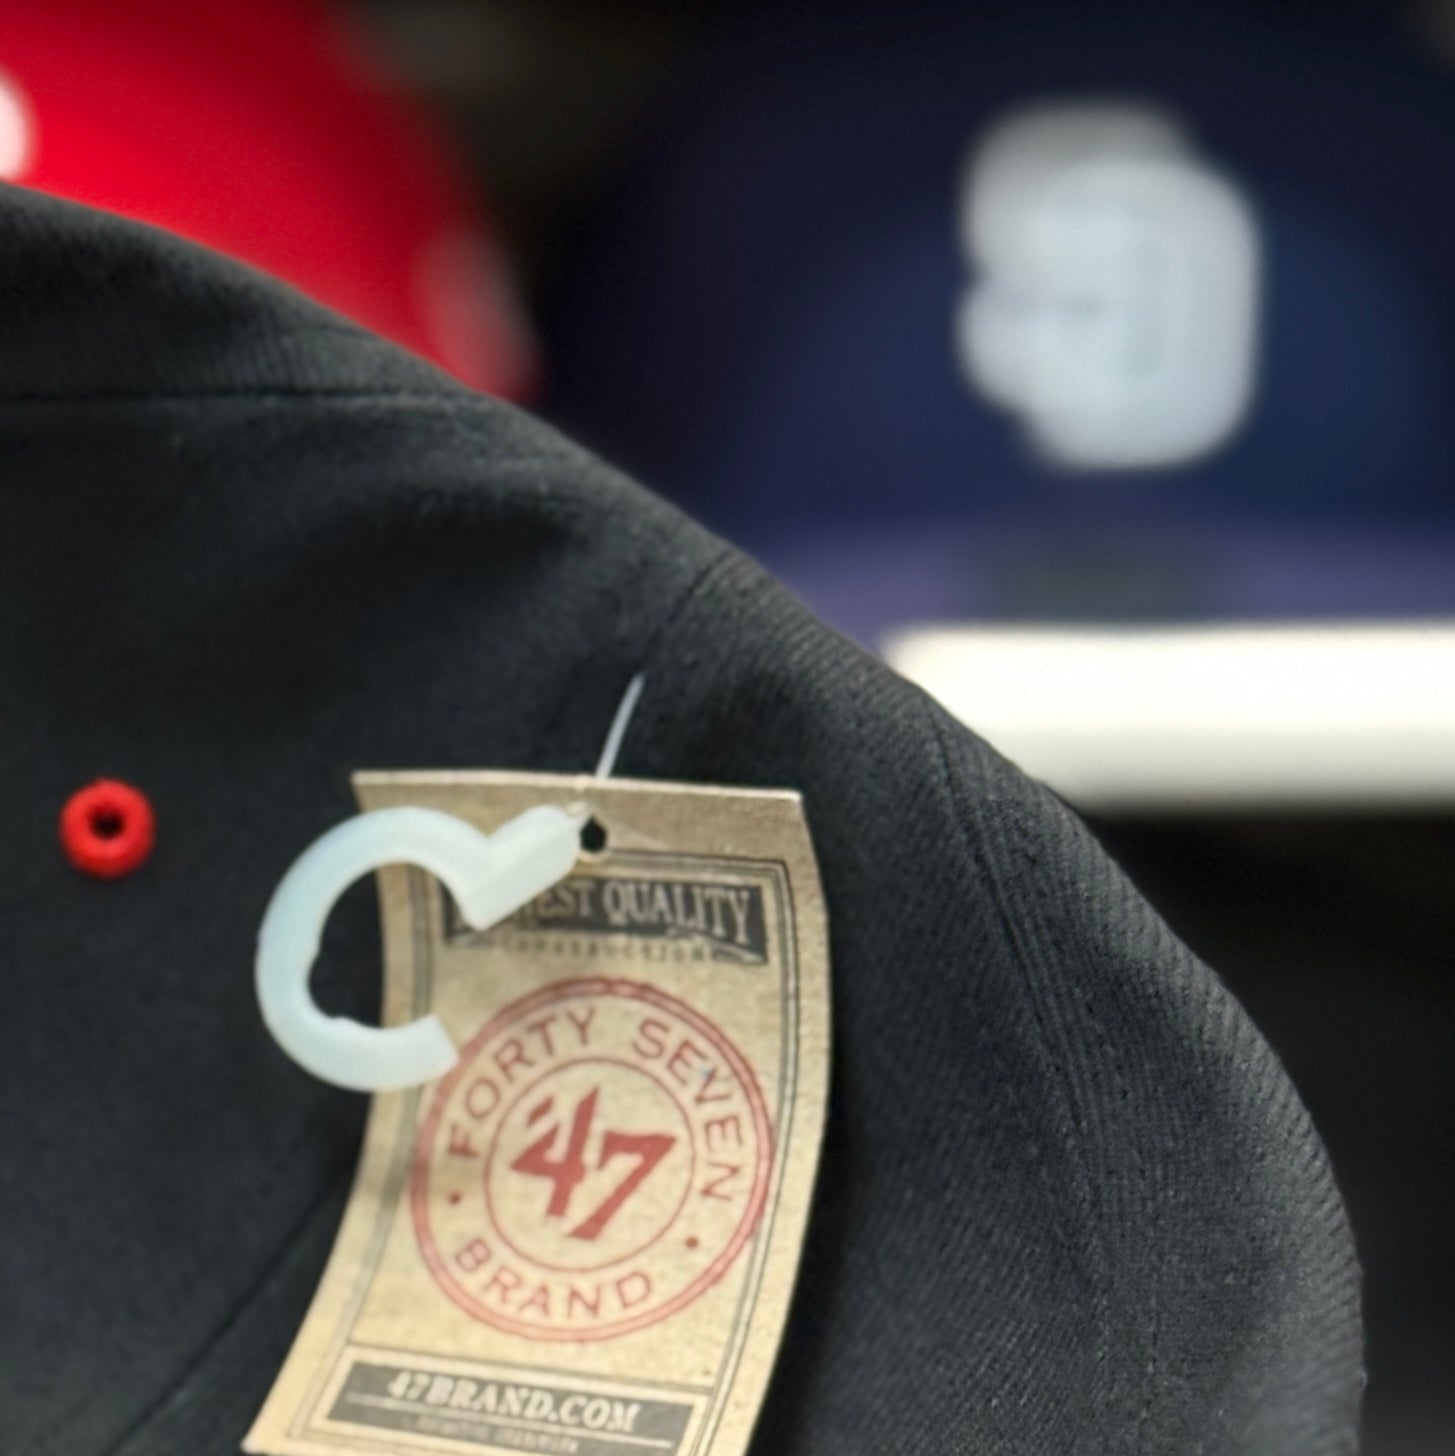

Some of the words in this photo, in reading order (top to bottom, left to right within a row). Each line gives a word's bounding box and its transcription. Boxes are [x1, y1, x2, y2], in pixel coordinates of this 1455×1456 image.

[602, 880, 751, 945] QUALITY
[448, 1006, 596, 1159] FORTY
[632, 1018, 743, 1202] SEVEN
[454, 1237, 652, 1318] BRAND
